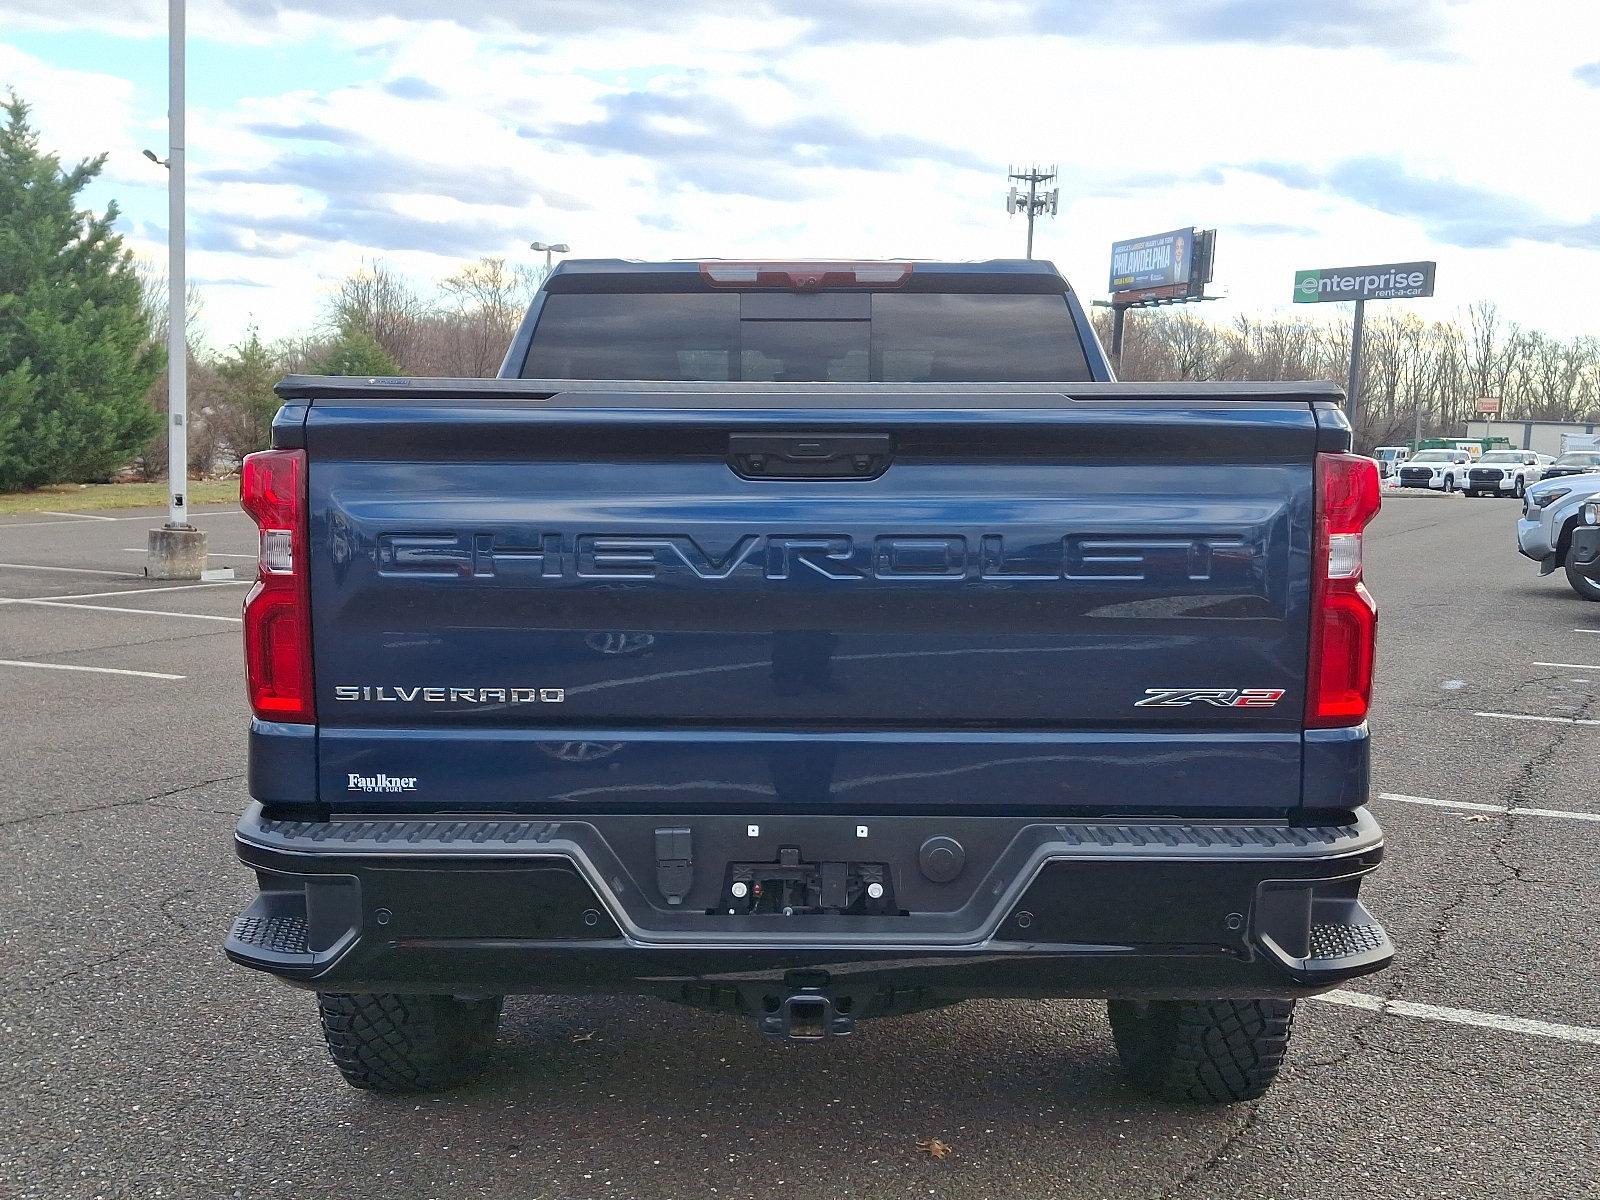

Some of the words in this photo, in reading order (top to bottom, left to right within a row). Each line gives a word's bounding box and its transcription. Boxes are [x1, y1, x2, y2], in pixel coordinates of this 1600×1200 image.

[1113, 245, 1171, 276] PHILAWDELPHIA
[1300, 269, 1424, 295] enterprise
[1375, 287, 1423, 297] rent-a-car
[376, 530, 1244, 583] CHEVROLET
[334, 686, 565, 703] SILVERADO
[1134, 688, 1286, 708] ZR2
[348, 773, 417, 788] Faulkner
